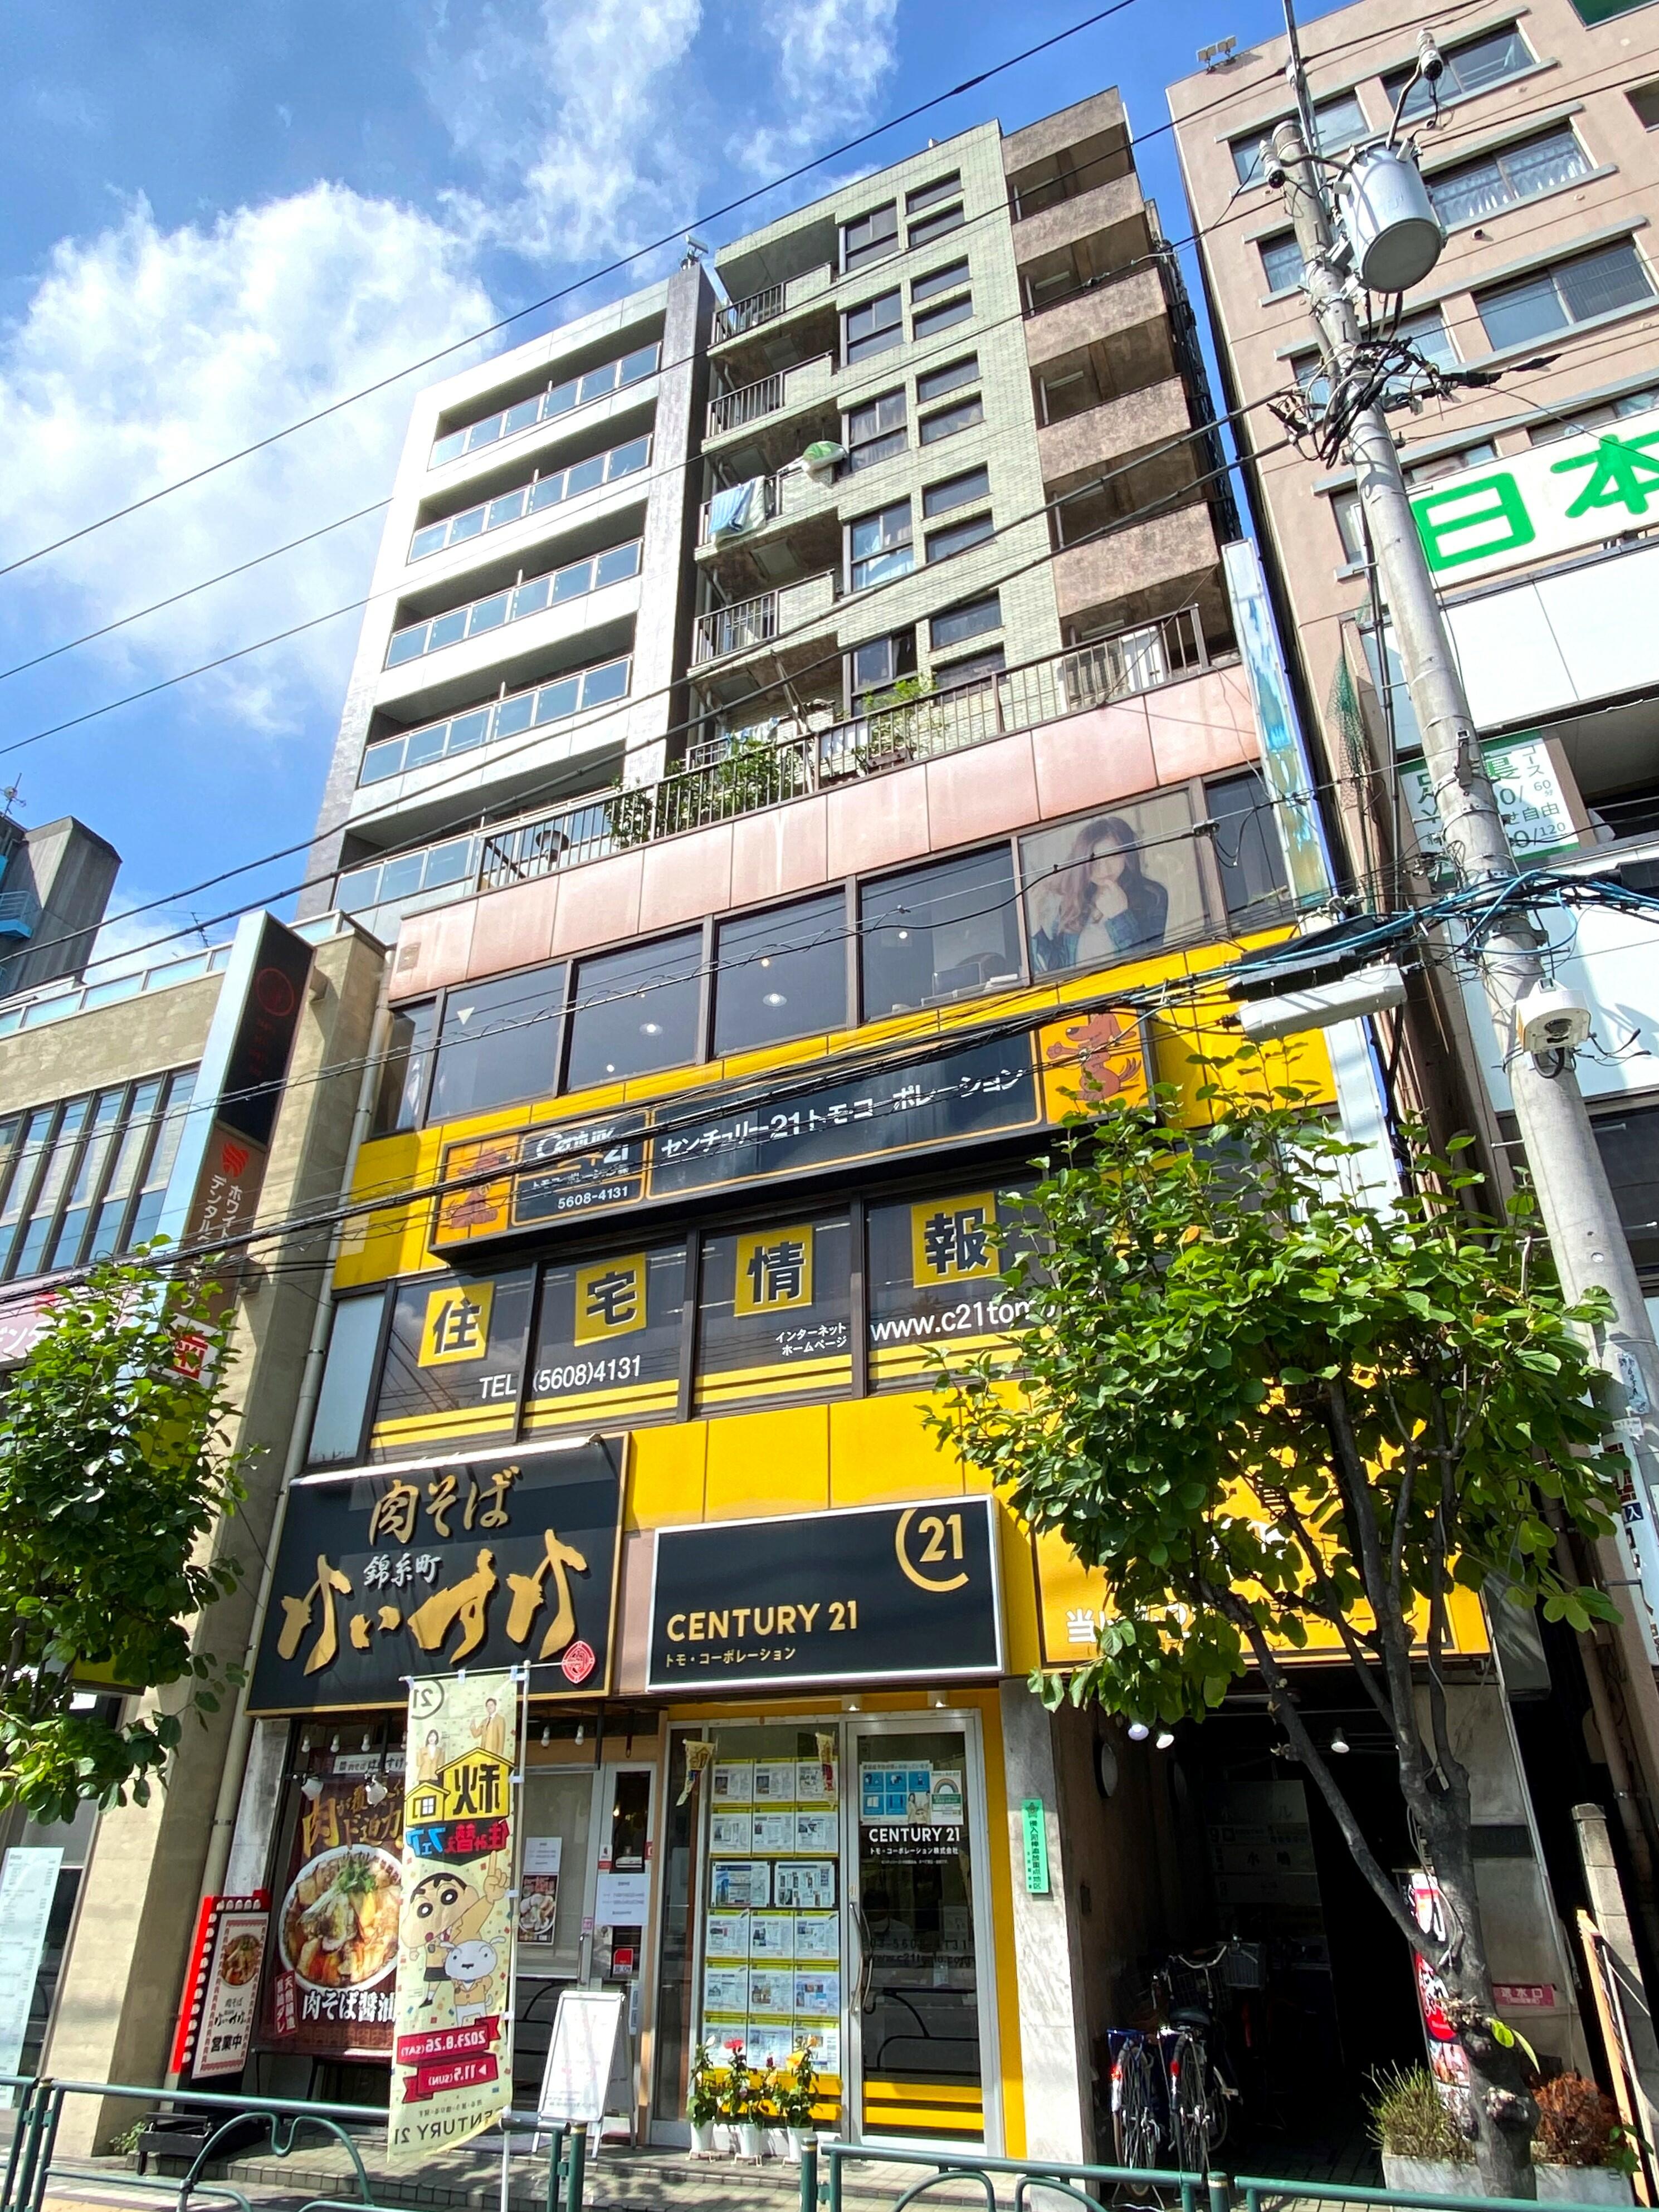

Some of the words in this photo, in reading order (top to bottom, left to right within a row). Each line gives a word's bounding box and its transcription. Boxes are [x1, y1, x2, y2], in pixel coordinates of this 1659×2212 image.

[557, 1185, 628, 1210] 5608-4131
[775, 1321, 847, 1345] インターネット
[781, 1335, 847, 1357] ホームページ
[479, 1374, 517, 1399] TEL
[532, 1354, 641, 1393] (5608)4131
[369, 1466, 520, 1545] 肉そば
[363, 1552, 442, 1591] 錦糸町
[666, 1603, 821, 1642] CENTURY
[828, 1600, 857, 1632] 21
[868, 1827, 943, 1843] CENTURY
[946, 1827, 960, 1842] 21
[211, 2033, 243, 2054] 営業中
